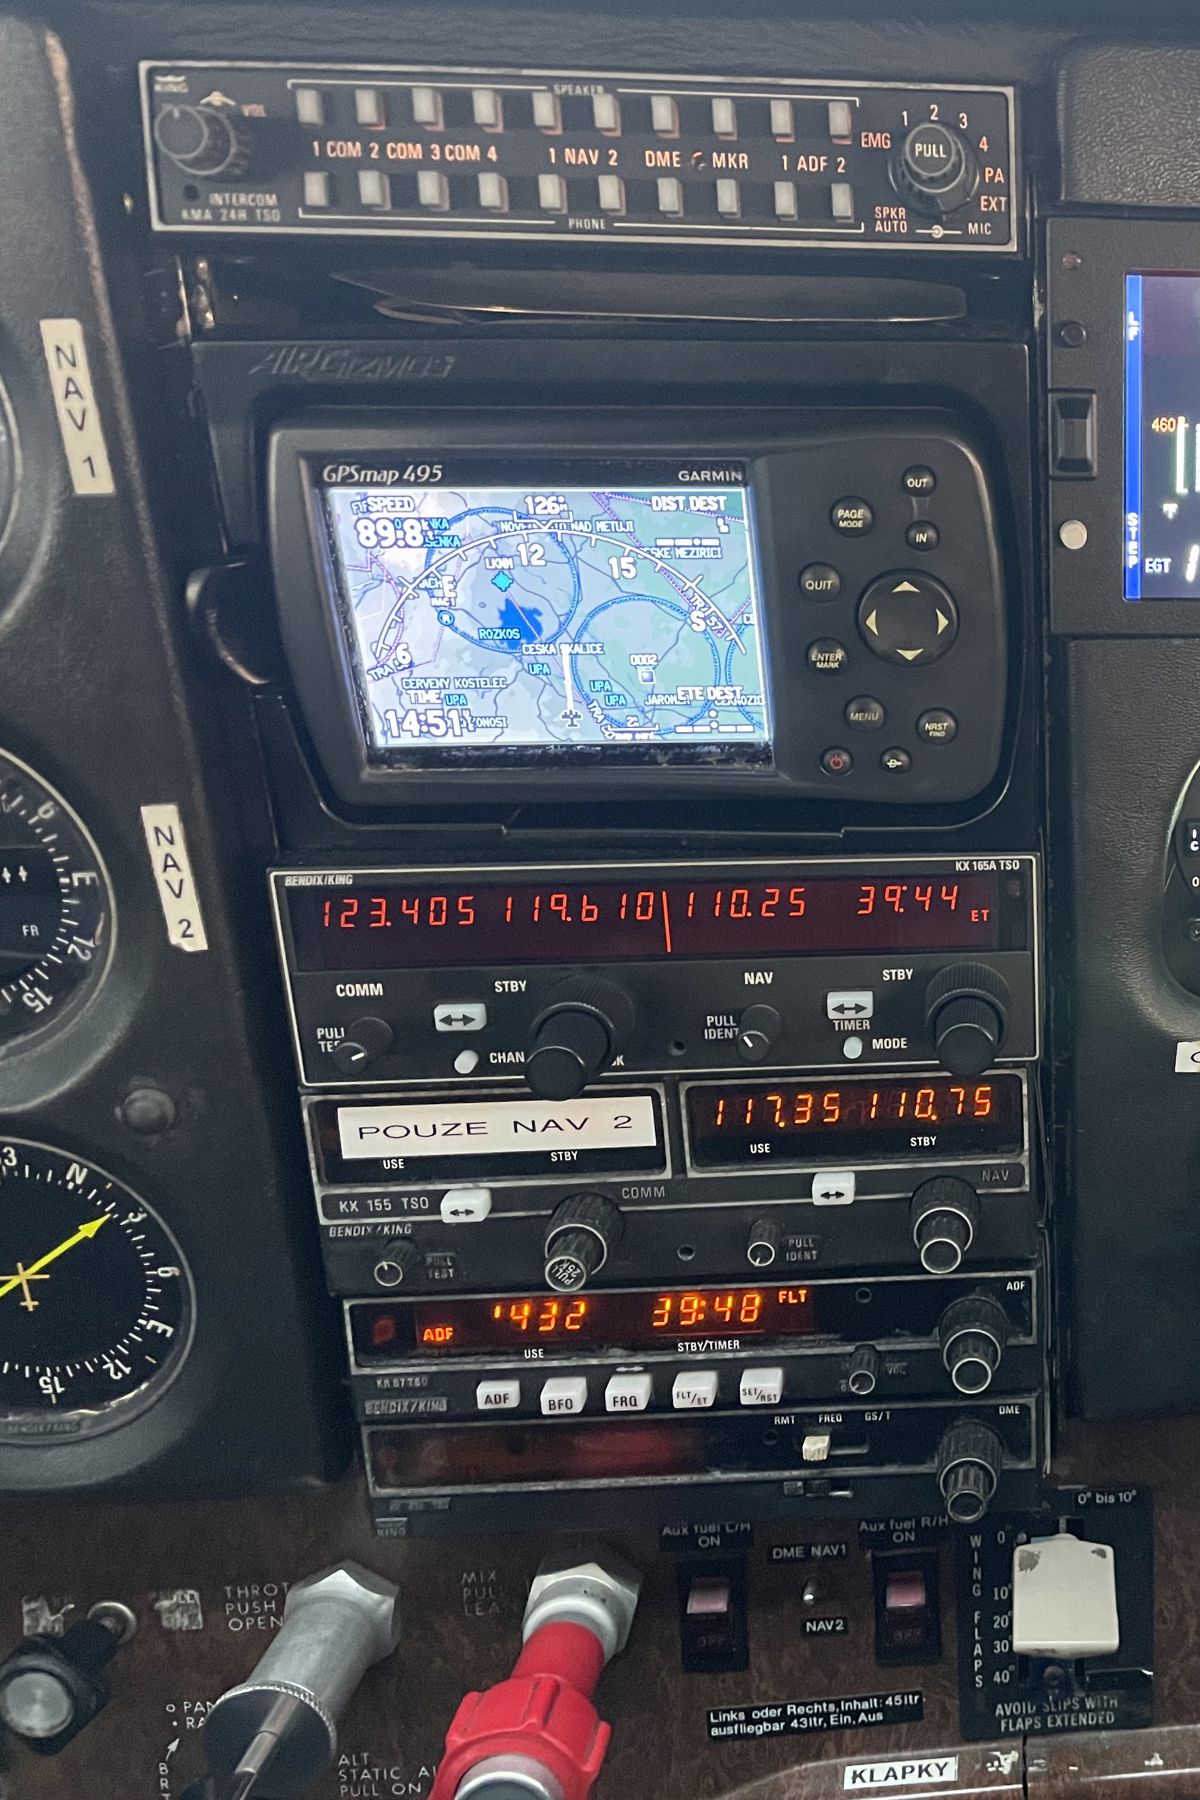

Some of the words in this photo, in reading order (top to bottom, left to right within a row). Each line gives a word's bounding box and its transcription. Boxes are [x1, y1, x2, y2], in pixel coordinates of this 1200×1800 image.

[860, 132, 891, 149] EMG
[549, 148, 556, 164] 1
[564, 149, 598, 166] NAV
[608, 150, 618, 166] 2
[914, 143, 947, 158] PULL
[645, 151, 681, 167] DME
[712, 152, 749, 169] MKR
[874, 206, 906, 220] SPKR
[568, 218, 606, 230] PHONE
[874, 219, 907, 233] AUTO
[55, 344, 86, 431] NAV
[83, 456, 96, 478] 1
[323, 464, 399, 486] GPSmap
[403, 464, 442, 482] 495
[678, 470, 743, 481] GARMIN
[907, 479, 927, 487] OUT
[367, 496, 415, 512] SPEED
[838, 509, 864, 519] PAGE
[1145, 558, 1172, 574] EGT
[805, 580, 833, 590] QUIT
[478, 628, 521, 640] ROZKOS
[402, 678, 450, 690] CERVENY
[454, 677, 507, 688] KOSTELEC
[385, 709, 462, 738] 14:51
[850, 712, 879, 721] MENU
[925, 723, 948, 731] NRST
[956, 860, 970, 871] KX
[972, 860, 996, 871] 165A
[999, 860, 1020, 870] TSO
[154, 826, 183, 898] NAV
[178, 919, 194, 938] 2
[284, 874, 353, 886] BENDIX/KING
[506, 891, 654, 922] 119.610
[687, 888, 806, 918] 110.25
[858, 884, 959, 916] 39:44
[323, 896, 475, 928] 123.405
[971, 909, 989, 922] ET
[744, 971, 773, 985] NAV
[882, 969, 913, 981] STBY
[336, 982, 384, 997] COMM
[494, 980, 527, 993] STBY
[706, 1015, 736, 1028] PULL
[833, 1019, 871, 1031] TIMER
[872, 1038, 908, 1049] MODE
[489, 1051, 525, 1064] CHAN
[716, 1092, 841, 1128] 117.35
[870, 1086, 991, 1121] 110.75
[358, 1121, 488, 1140] POUZE
[512, 1117, 590, 1133] NAV
[613, 1115, 632, 1129] 2
[911, 1136, 937, 1147] STBY
[551, 1150, 578, 1162] STBY
[339, 1200, 358, 1212] KX
[368, 1198, 391, 1211] 155
[402, 1196, 429, 1210] TSO
[1006, 1281, 1026, 1291] ADF
[654, 1293, 761, 1328] 39:48
[678, 1339, 740, 1352] STBY/TIMER
[485, 1393, 509, 1405] ADF
[548, 1398, 573, 1411] BFO
[612, 1395, 638, 1407] FRQ
[773, 1546, 805, 1559] DME
[811, 1544, 847, 1557] NAV1
[226, 1602, 276, 1615] PUSH
[806, 1619, 844, 1632] NAV2
[710, 1709, 746, 1723] Links
[752, 1707, 782, 1720] oder
[787, 1702, 839, 1716] Rechts,
[830, 1713, 855, 1725] Ein,
[858, 1711, 884, 1723] Aus
[1001, 1716, 1042, 1732] FLAPS
[1047, 1711, 1115, 1728] EXTENDED
[338, 1754, 370, 1767] ALT
[339, 1767, 400, 1782] STATIC
[852, 1761, 949, 1784] KLAPKY
[340, 1783, 379, 1796] PULL
[392, 1782, 422, 1795] ON
